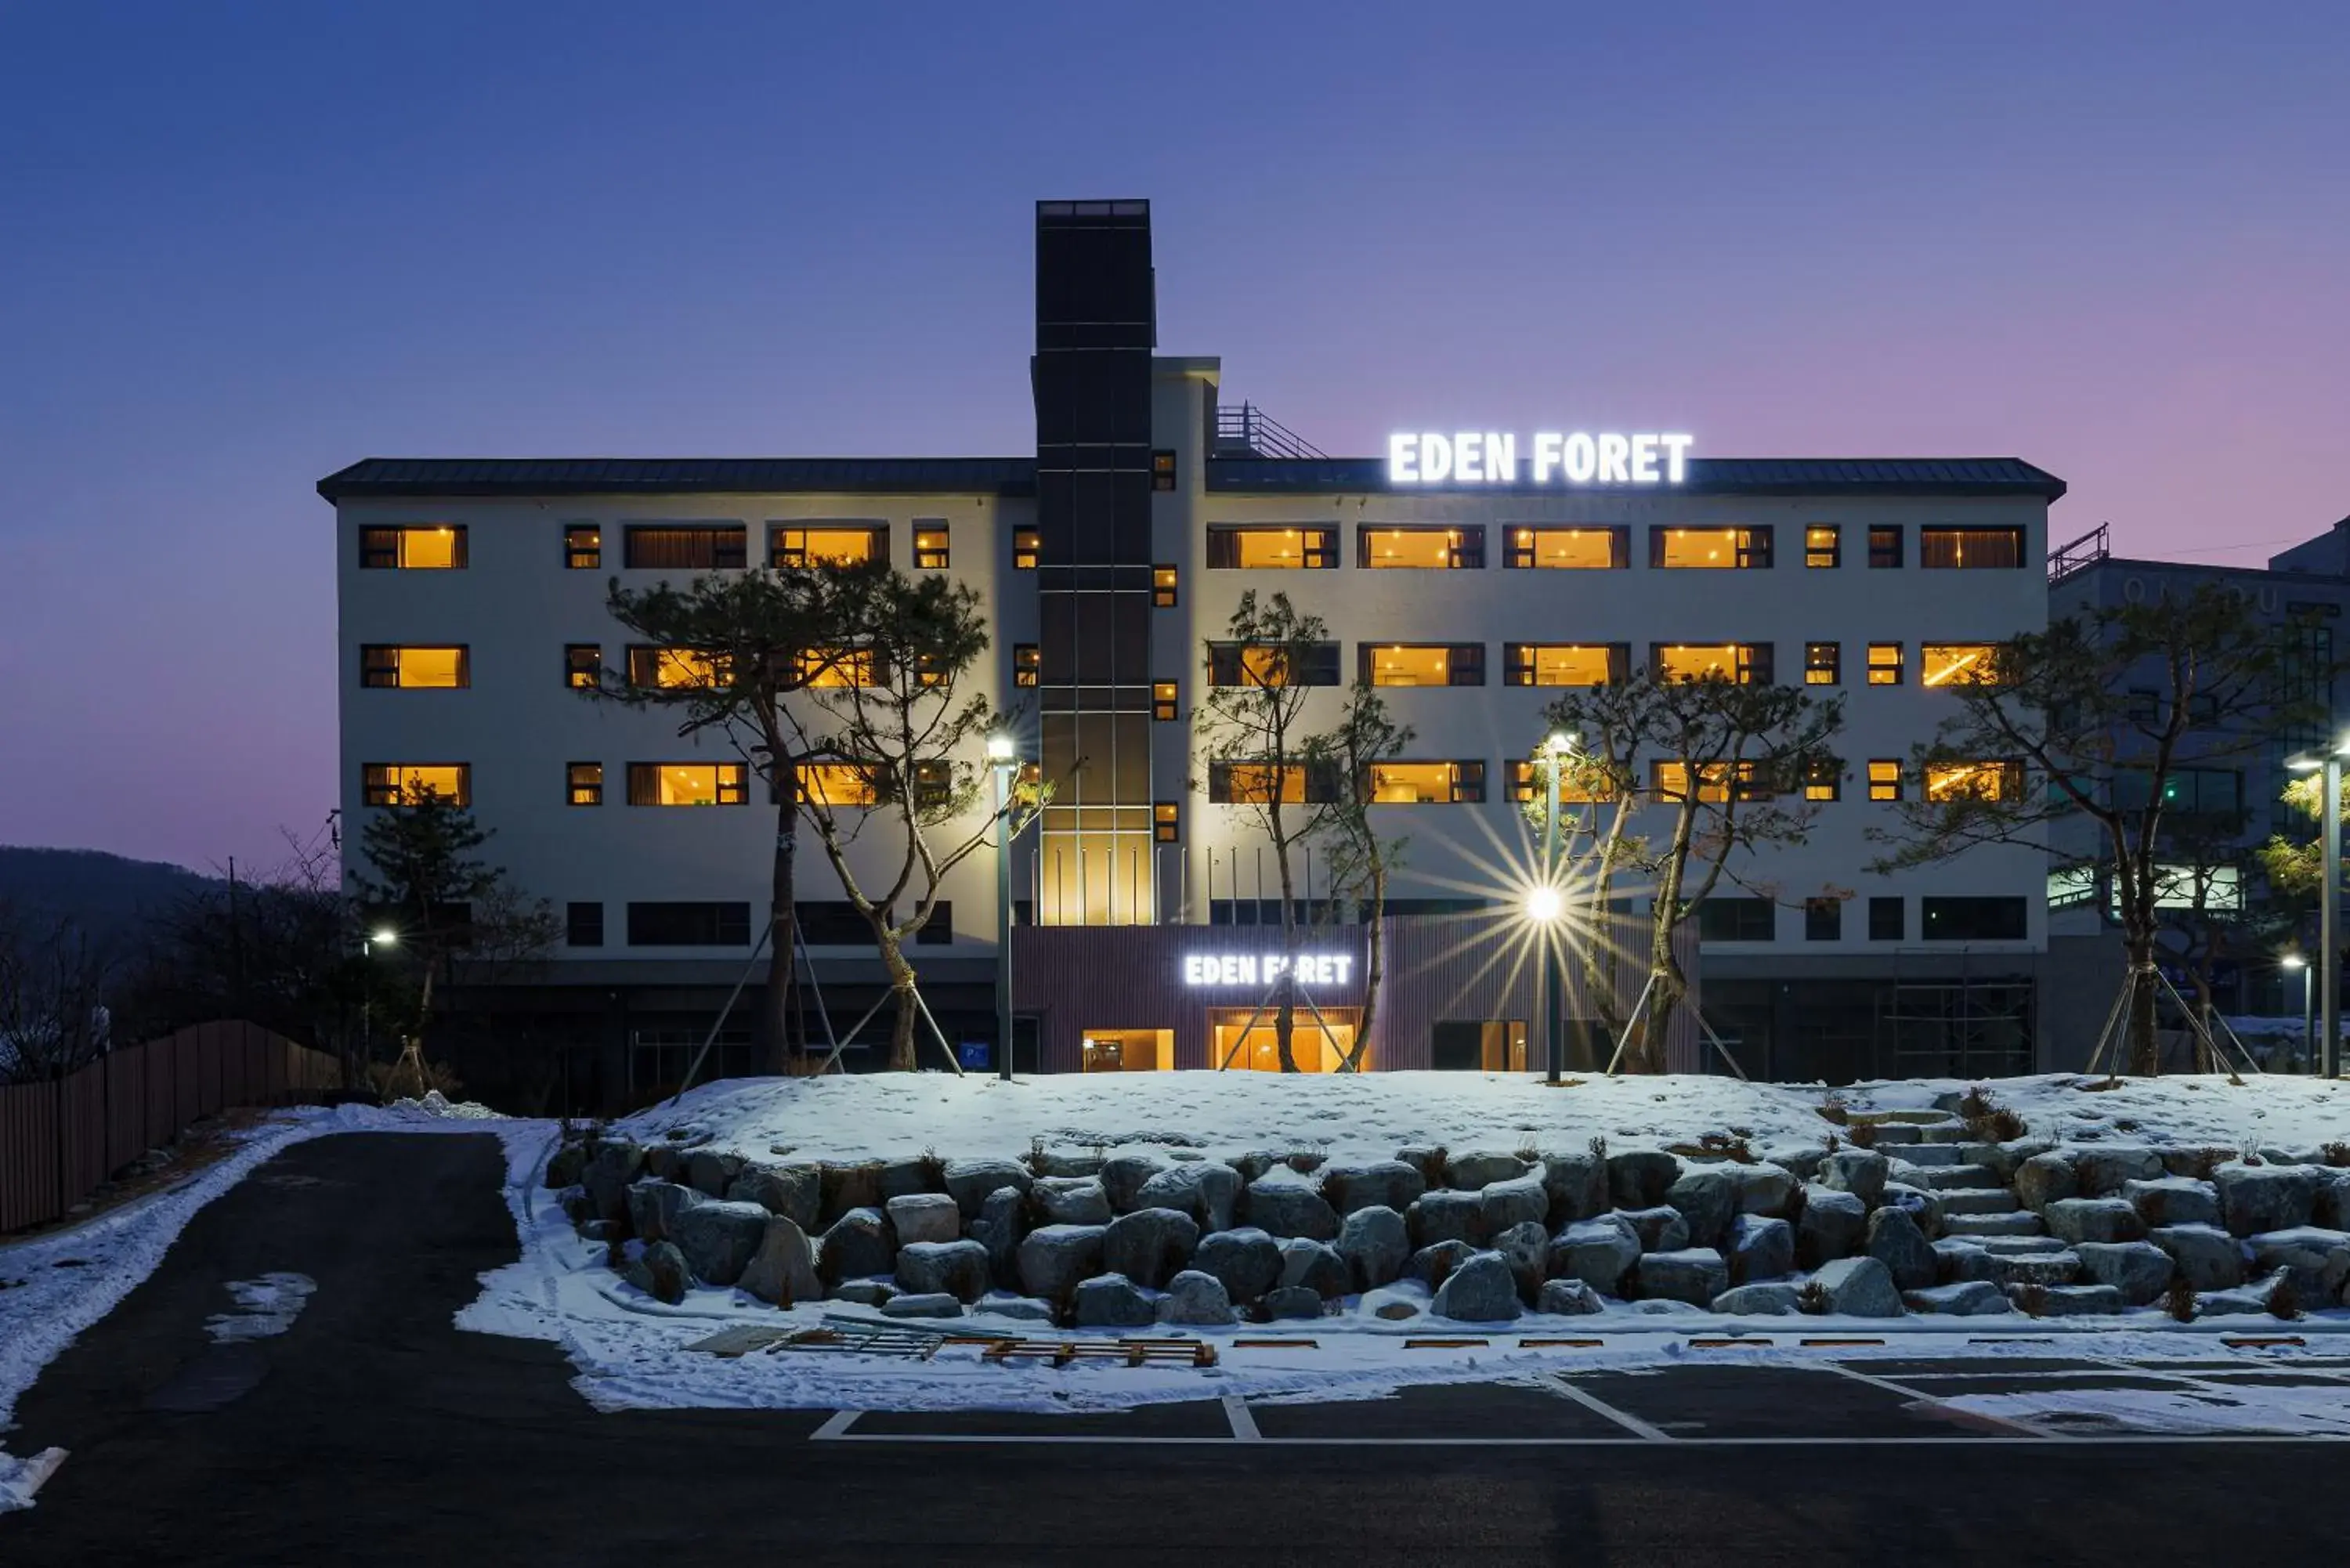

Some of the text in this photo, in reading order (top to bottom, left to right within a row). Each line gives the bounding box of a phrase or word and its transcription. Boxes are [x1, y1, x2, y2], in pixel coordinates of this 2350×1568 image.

[1389, 432, 1693, 482] EDEN FORET
[1185, 955, 1256, 985] EDEN
